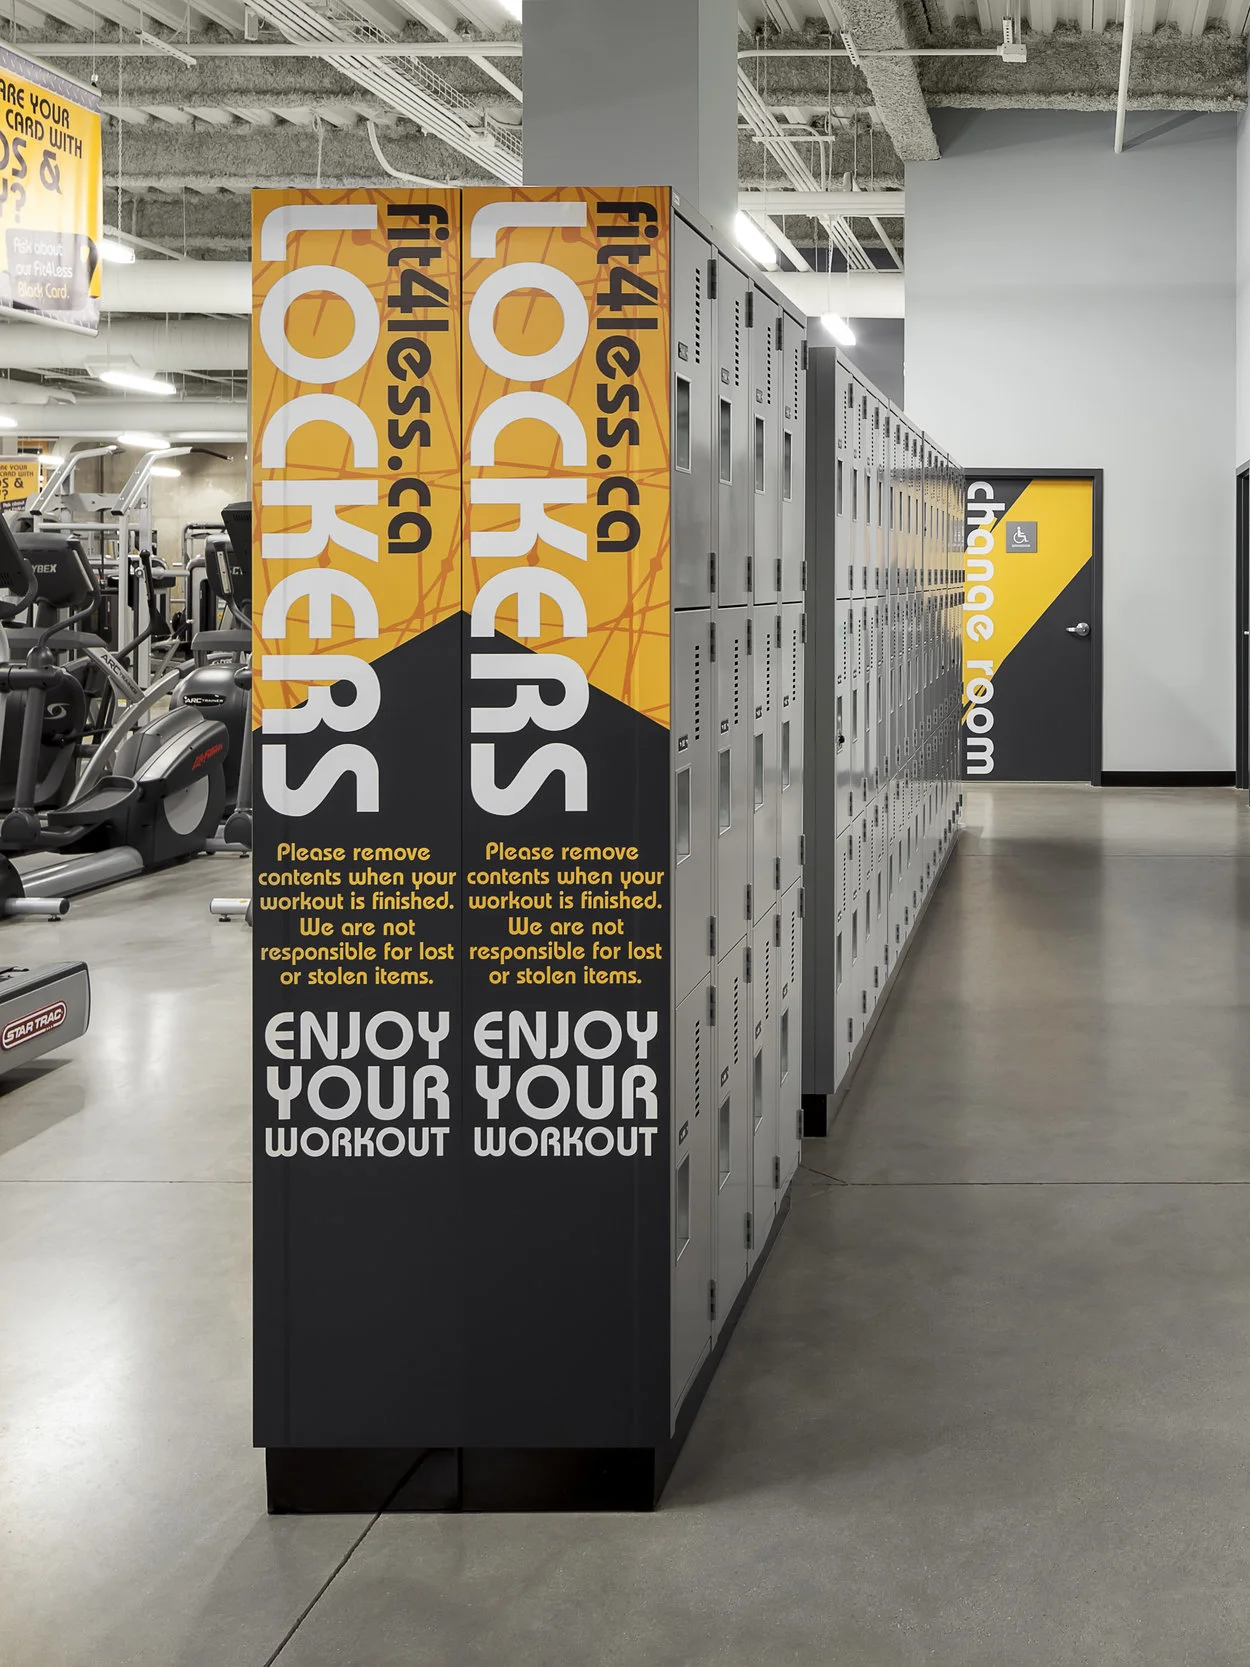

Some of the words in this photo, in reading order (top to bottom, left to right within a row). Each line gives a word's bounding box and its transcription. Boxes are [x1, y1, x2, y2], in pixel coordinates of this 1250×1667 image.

[30, 93, 69, 129] YOUR
[5, 109, 44, 140] CARD
[50, 126, 82, 159] WITH
[40, 149, 63, 195] &
[34, 241, 64, 257] about
[15, 262, 32, 276] our
[18, 281, 43, 298] Black
[45, 282, 70, 300] Card.
[387, 203, 450, 554] fit4less.ca
[596, 201, 659, 553] fit4less.ca
[0, 477, 9, 489] S
[14, 477, 24, 489] &
[259, 203, 381, 817] LOCKERS
[468, 201, 590, 816] LOCKERS
[31, 563, 58, 574] YBEX
[963, 481, 1005, 642] change
[100, 654, 121, 675] ARC
[966, 660, 995, 775] room
[278, 842, 346, 862] Please
[353, 847, 431, 862] remove
[486, 841, 554, 861] Please
[562, 846, 640, 861] remove
[258, 868, 341, 887] contents
[349, 866, 403, 886] when
[412, 871, 457, 891] your
[466, 867, 550, 886] contents
[558, 865, 612, 885] when
[620, 870, 666, 890] your
[260, 891, 344, 911] workout
[351, 891, 365, 910] is
[372, 890, 454, 910] finished.
[468, 890, 552, 910] workout
[560, 890, 574, 909] is
[580, 889, 662, 909] finished.
[299, 917, 334, 937] We
[341, 922, 376, 936] are
[383, 919, 416, 936] not
[508, 916, 542, 936] We
[550, 921, 584, 935] are
[592, 918, 624, 935] not
[261, 941, 377, 966] responsible
[384, 941, 413, 961] for
[420, 941, 454, 961] lost
[470, 940, 586, 965] responsible
[592, 940, 622, 960] for
[628, 940, 662, 960] lost
[280, 970, 301, 985] or
[308, 966, 368, 985] stolen
[375, 965, 434, 985] items.
[488, 969, 510, 984] or
[516, 965, 576, 984] stolen
[584, 964, 642, 984] items.
[4, 1021, 33, 1043] STAR
[35, 1008, 62, 1030] TRAC
[265, 1010, 450, 1060] ENJOY
[474, 1009, 658, 1059] ENJOY
[266, 1064, 450, 1121] YOUR
[474, 1063, 658, 1120] YOUR
[265, 1126, 450, 1158] WORKOUT
[474, 1125, 658, 1157] WORKOUT
